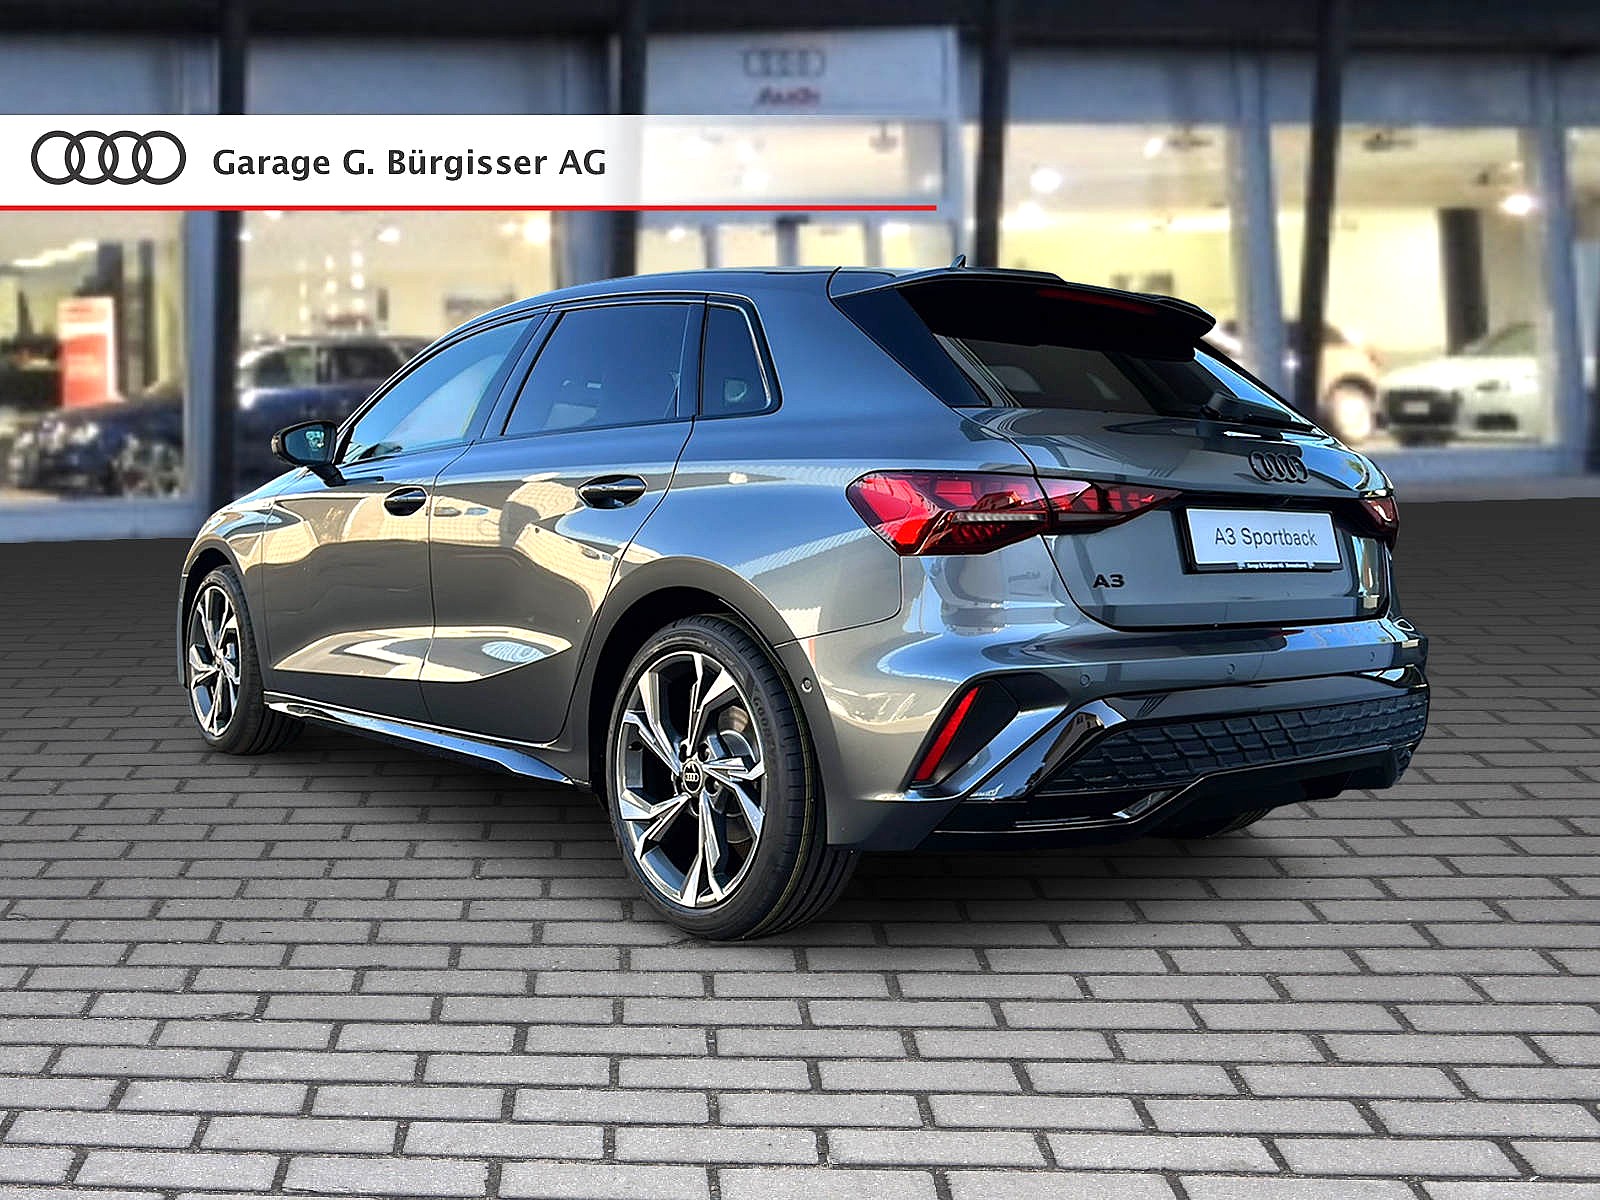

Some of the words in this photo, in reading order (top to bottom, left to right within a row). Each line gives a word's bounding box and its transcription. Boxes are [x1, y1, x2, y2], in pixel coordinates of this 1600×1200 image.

[1215, 527, 1236, 545] A3
[1240, 527, 1318, 549] Sportback
[1092, 573, 1125, 589] A3
